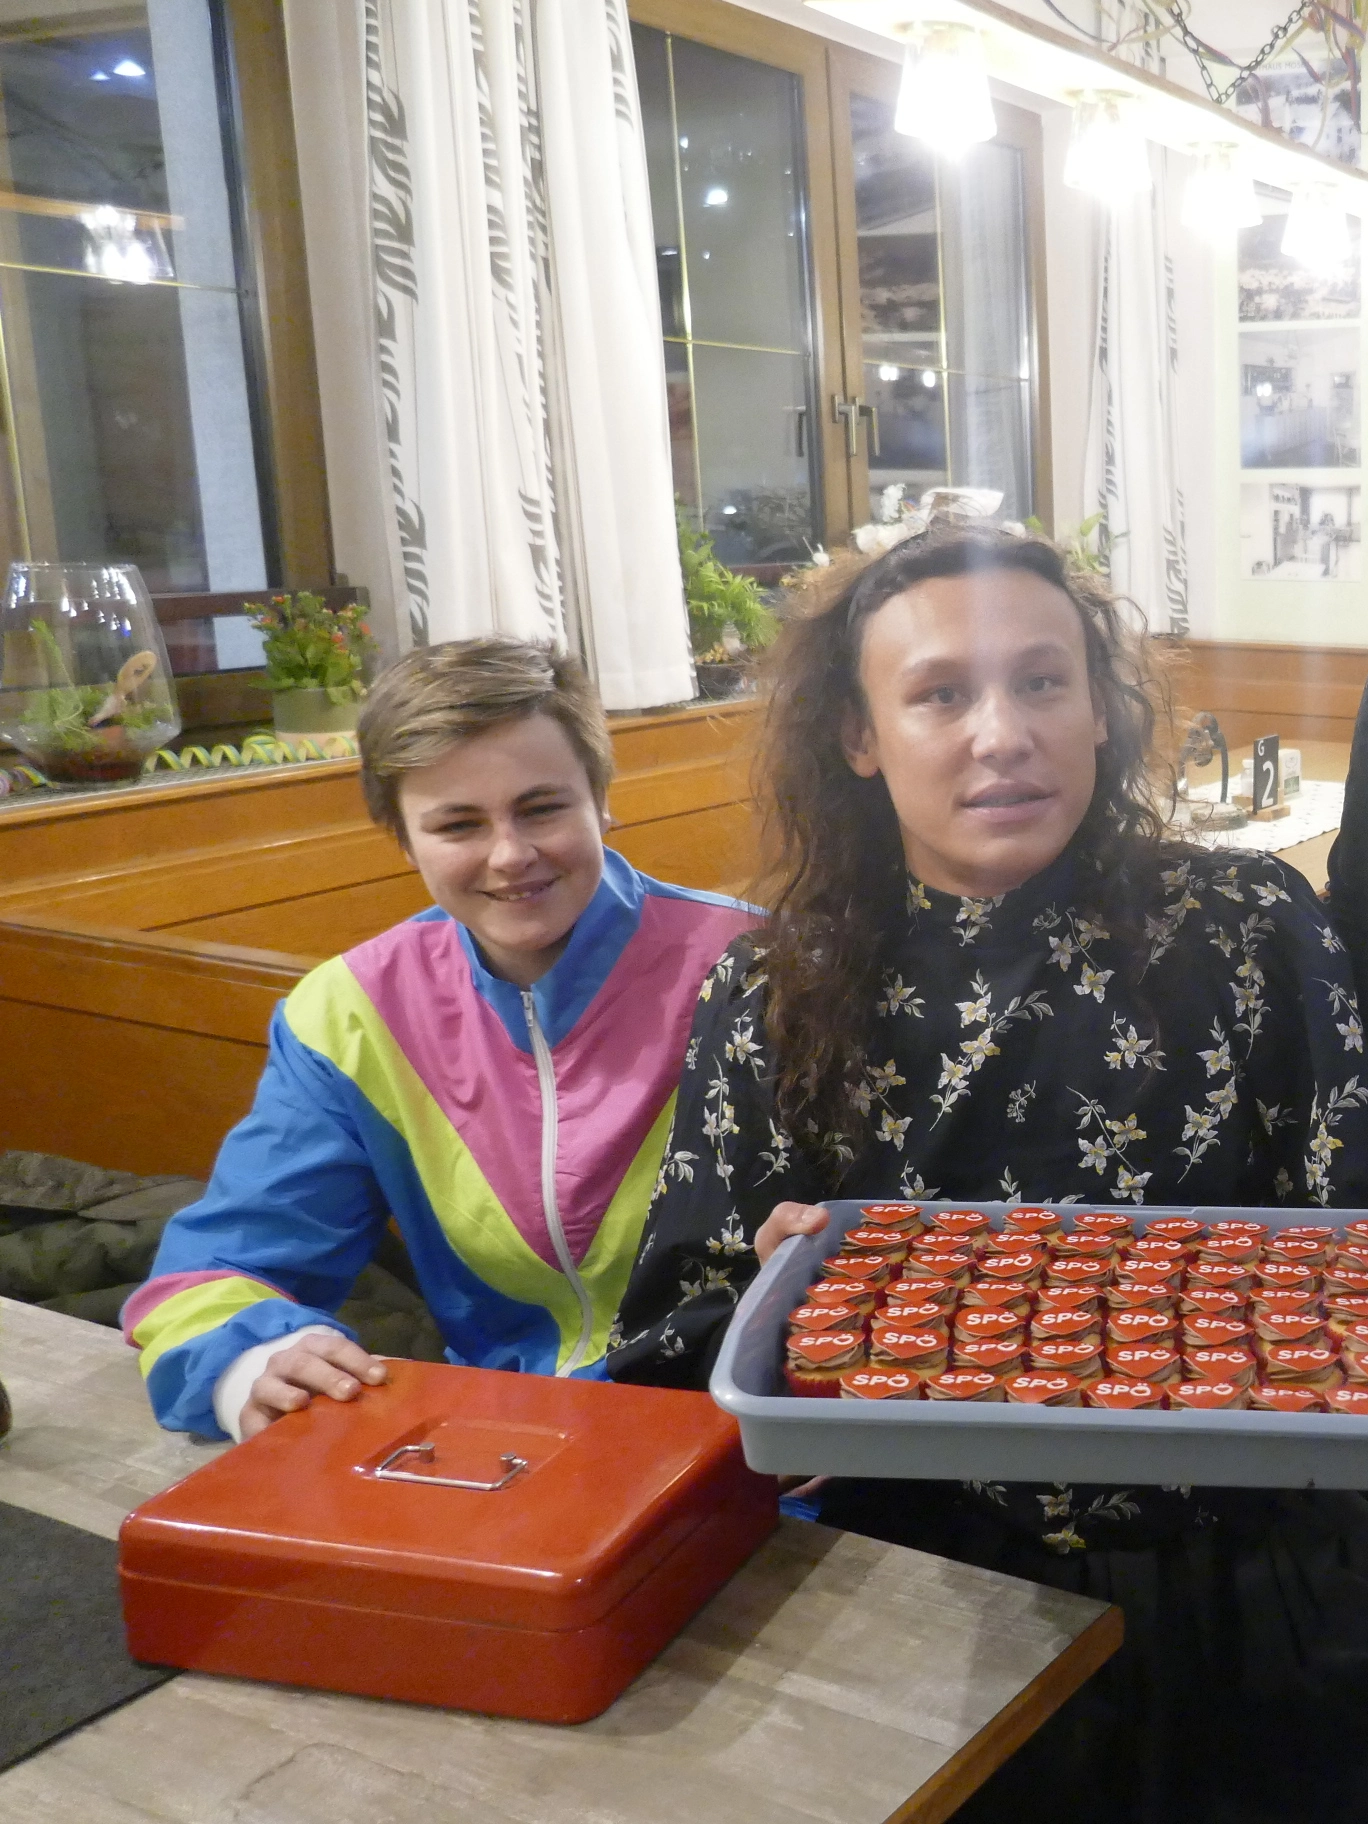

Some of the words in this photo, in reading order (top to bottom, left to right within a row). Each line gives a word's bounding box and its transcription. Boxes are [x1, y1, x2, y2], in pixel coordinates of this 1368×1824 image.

[1258, 740, 1265, 756] G
[1262, 761, 1274, 808] 2
[938, 1213, 983, 1221] SPÖ
[1012, 1210, 1056, 1220] SPÖ
[1154, 1220, 1198, 1228] SPÖ
[1217, 1222, 1261, 1230] SPÖ
[855, 1232, 901, 1240] SPÖ
[923, 1235, 970, 1243] SPÖ
[1207, 1236, 1252, 1247] SPÖ
[1136, 1241, 1181, 1250] SPÖ
[1273, 1241, 1318, 1249] SPÖ
[834, 1256, 883, 1264] SPÖ
[920, 1254, 968, 1262] SPÖ
[984, 1254, 1032, 1267] SPÖ
[1052, 1261, 1100, 1271] SPÖ
[1124, 1261, 1171, 1270] SPÖ
[1198, 1265, 1245, 1274] SPÖ
[1264, 1264, 1310, 1275] SPÖ
[814, 1283, 865, 1292] SPÖ
[895, 1281, 945, 1291] SPÖ
[1047, 1286, 1097, 1295] SPÖ
[1119, 1284, 1167, 1293] SPÖ
[1190, 1291, 1238, 1303] SPÖ
[796, 1306, 849, 1318] SPÖ
[887, 1304, 939, 1316] SPÖ
[966, 1312, 1017, 1325] SPÖ
[1041, 1311, 1091, 1324] SPÖ
[1117, 1314, 1169, 1326] SPÖ
[1270, 1315, 1320, 1324] SPÖ
[1195, 1319, 1245, 1331] SPÖ
[799, 1334, 854, 1346] SPÖ
[883, 1332, 937, 1347] SPÖ
[964, 1342, 1017, 1352] SPÖ
[1041, 1343, 1094, 1354] SPÖ
[1118, 1350, 1170, 1361] SPÖ
[1195, 1351, 1247, 1363] SPÖ
[1277, 1349, 1330, 1359] SPÖ
[852, 1374, 909, 1387] SPÖ
[939, 1373, 995, 1384] SPÖ
[1013, 1377, 1068, 1389] SPÖ
[1096, 1383, 1151, 1396] SPÖ
[1179, 1383, 1234, 1395] SPÖ
[1261, 1388, 1313, 1398] SPÖ
